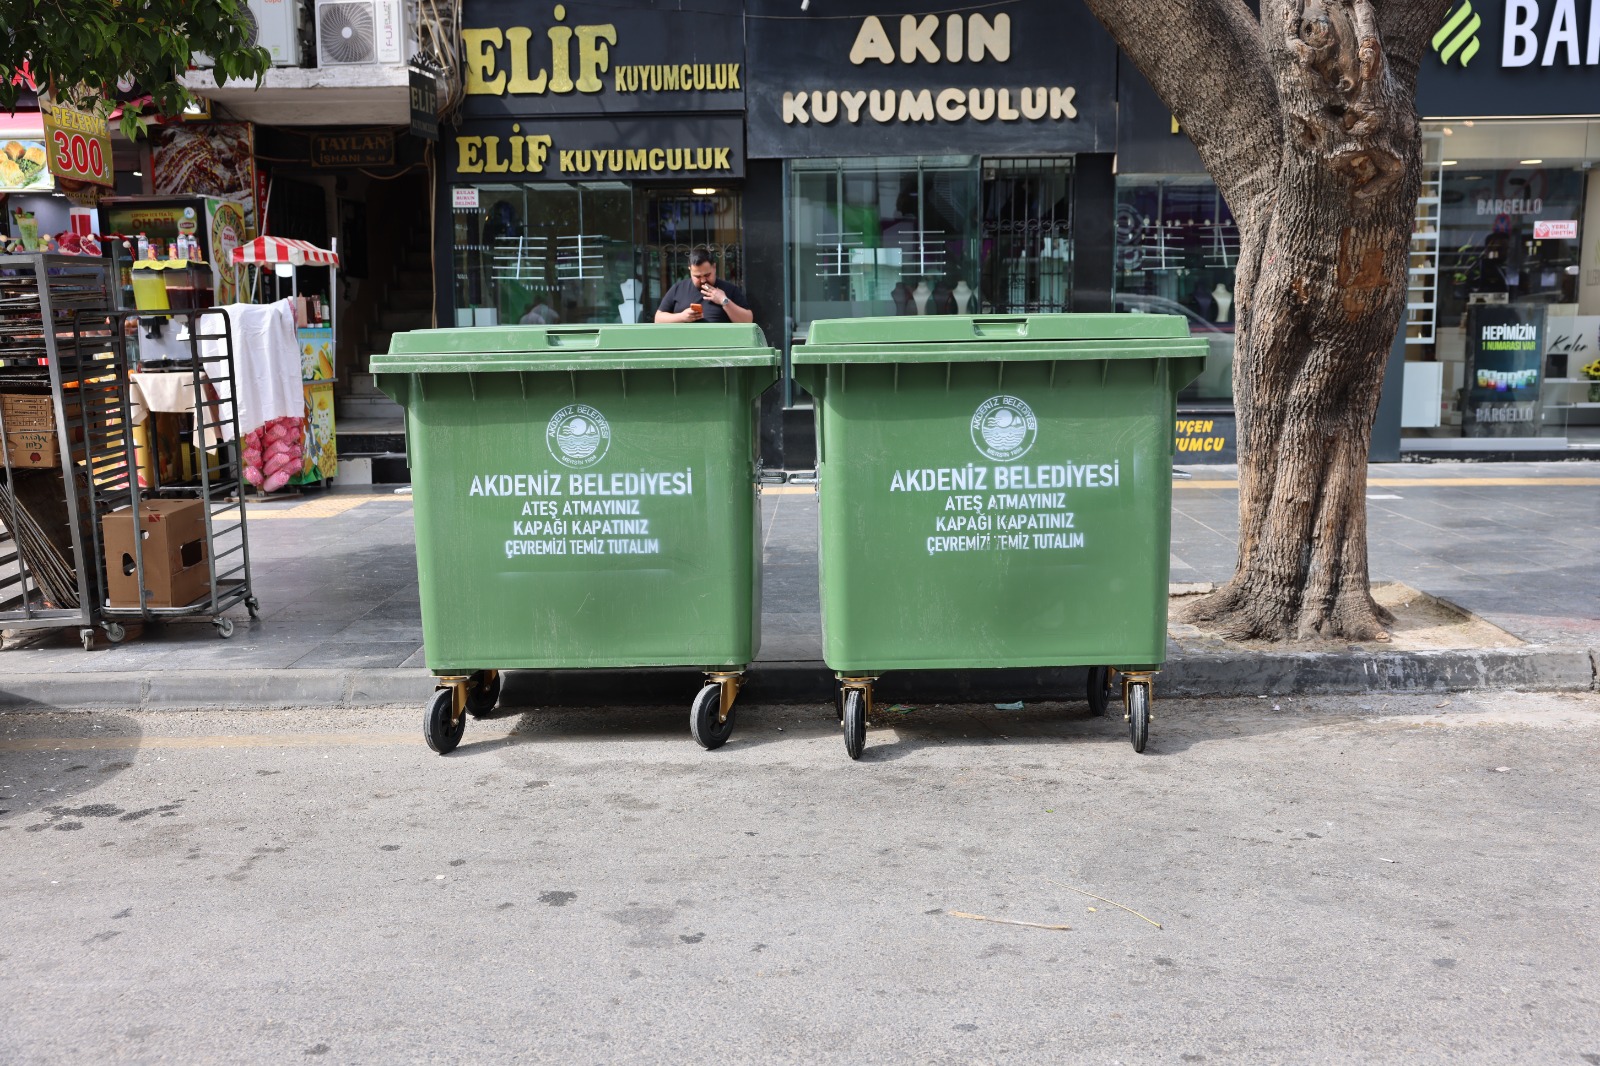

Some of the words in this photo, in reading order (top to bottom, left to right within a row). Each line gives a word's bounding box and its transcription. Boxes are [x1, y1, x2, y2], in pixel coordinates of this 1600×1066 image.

[849, 13, 1011, 65] AKIN
[462, 4, 617, 96] ELİF
[615, 63, 740, 92] KUYUMCULUK
[782, 86, 1078, 124] KUYUMCULUK
[317, 135, 387, 151] TAYLAN
[456, 123, 552, 174] ELİF
[559, 148, 731, 172] KUYUMCULUK
[54, 130, 103, 177] 300
[1477, 198, 1543, 215] BARGELLO
[1482, 323, 1537, 340] HEPİMİZİN
[1487, 341, 1521, 350] NUMARASI
[1522, 341, 1536, 350] VAR
[1476, 407, 1533, 422] BARGELLO
[469, 470, 562, 497] AKDENİZ
[569, 467, 693, 496] BELEDİYESİ
[889, 463, 987, 492] AKDENİZ
[994, 459, 1119, 489] BELEDİYESİ
[522, 500, 558, 518] ATEŞ
[562, 499, 640, 515] ATMAYINIZ
[945, 494, 983, 514] ATEŞ
[987, 493, 1065, 510] ATMAYINIZ
[513, 518, 567, 536] KAPAĞI
[571, 519, 649, 535] KAPATINIZ
[936, 513, 992, 531] KAPAĞI
[997, 512, 1074, 530] KAPATINIZ
[505, 537, 567, 559] ÇEVREMİZİ
[569, 537, 604, 555] TEMİZ
[607, 538, 659, 554] TUTALIM
[1033, 532, 1084, 549] TUTALIM
